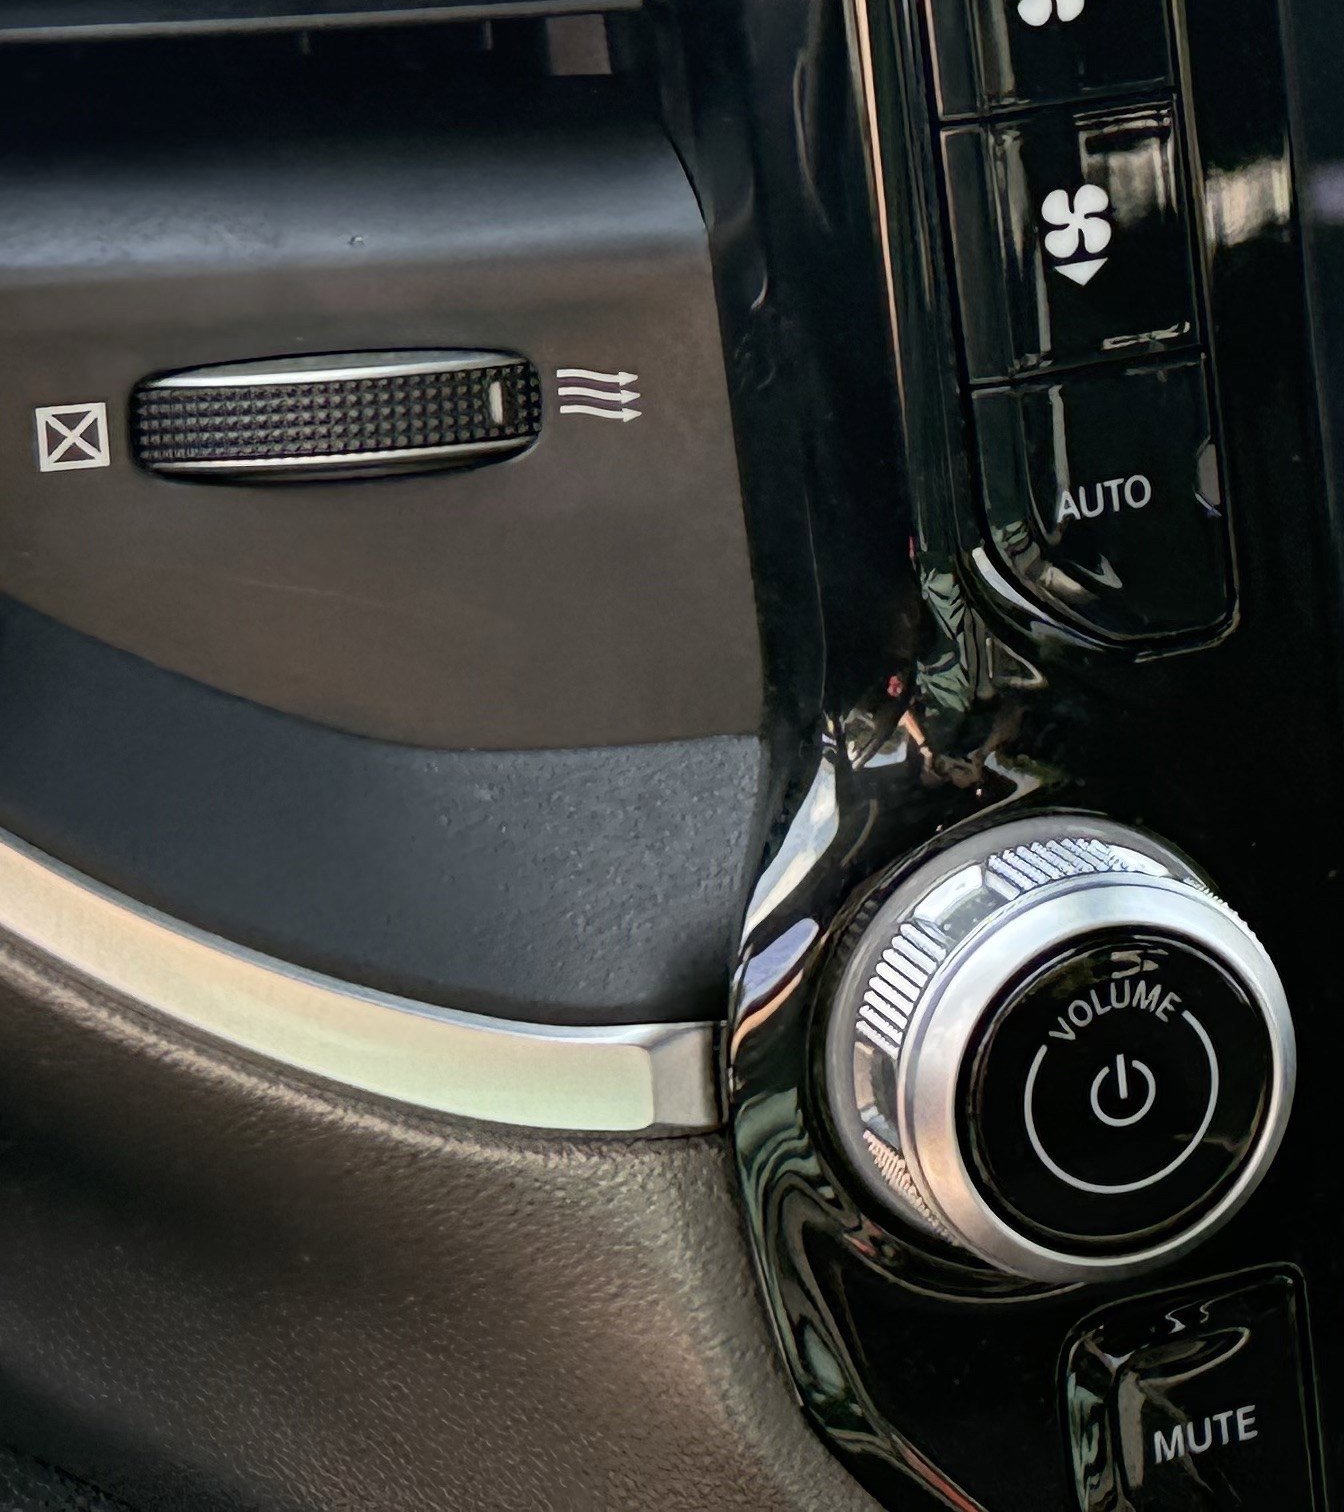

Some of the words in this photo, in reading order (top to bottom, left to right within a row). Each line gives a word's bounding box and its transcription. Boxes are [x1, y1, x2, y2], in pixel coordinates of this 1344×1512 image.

[1055, 473, 1152, 524] AUTO
[1049, 979, 1182, 1040] VOLUME
[1153, 1404, 1259, 1464] MUTE
